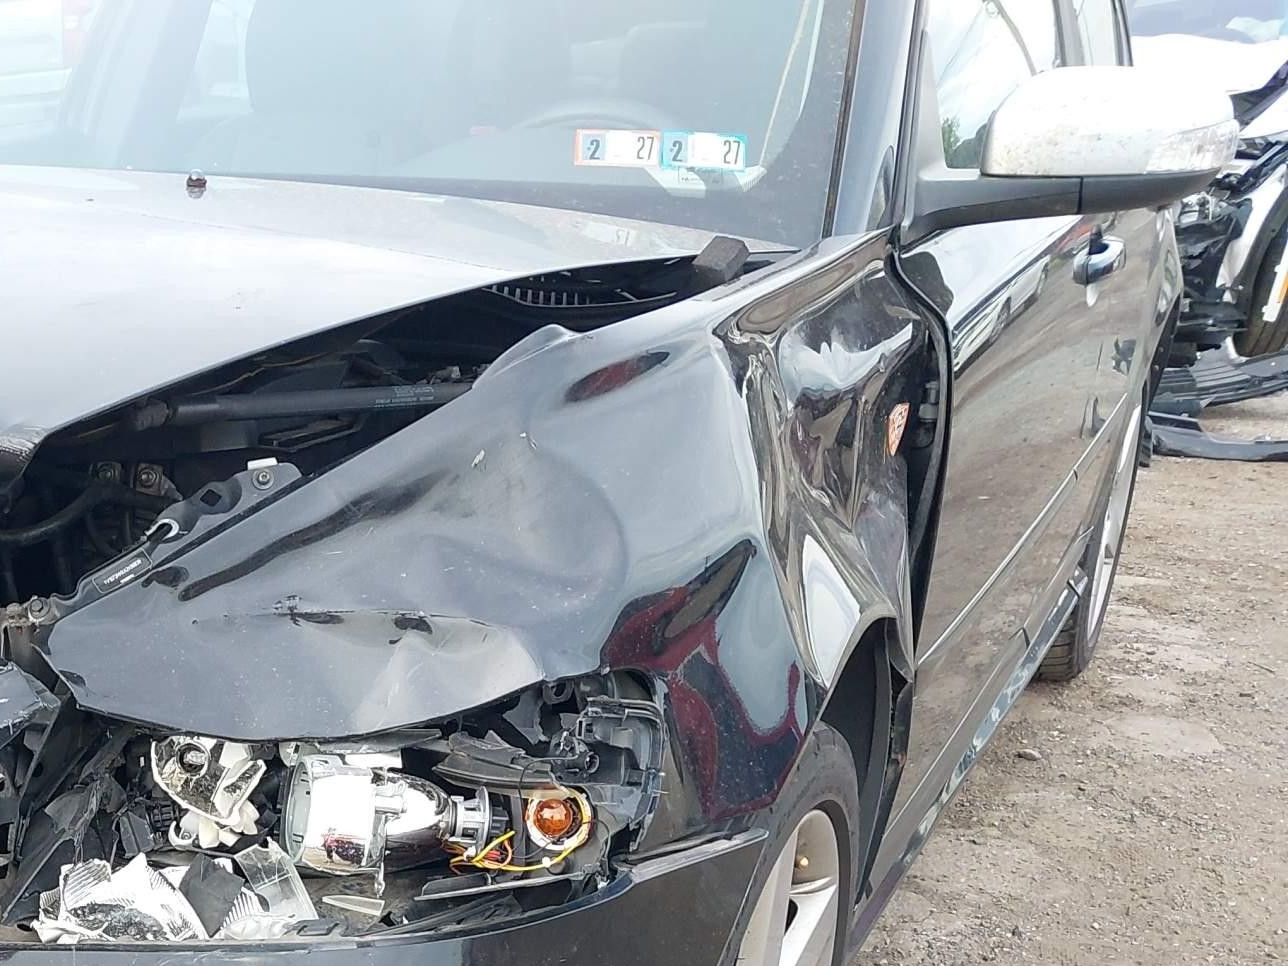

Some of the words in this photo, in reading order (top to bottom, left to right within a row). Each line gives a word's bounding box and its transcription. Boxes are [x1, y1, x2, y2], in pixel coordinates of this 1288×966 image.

[588, 138, 601, 161] 2
[636, 136, 655, 161] 27
[671, 139, 683, 163] 2
[722, 139, 741, 165] 27
